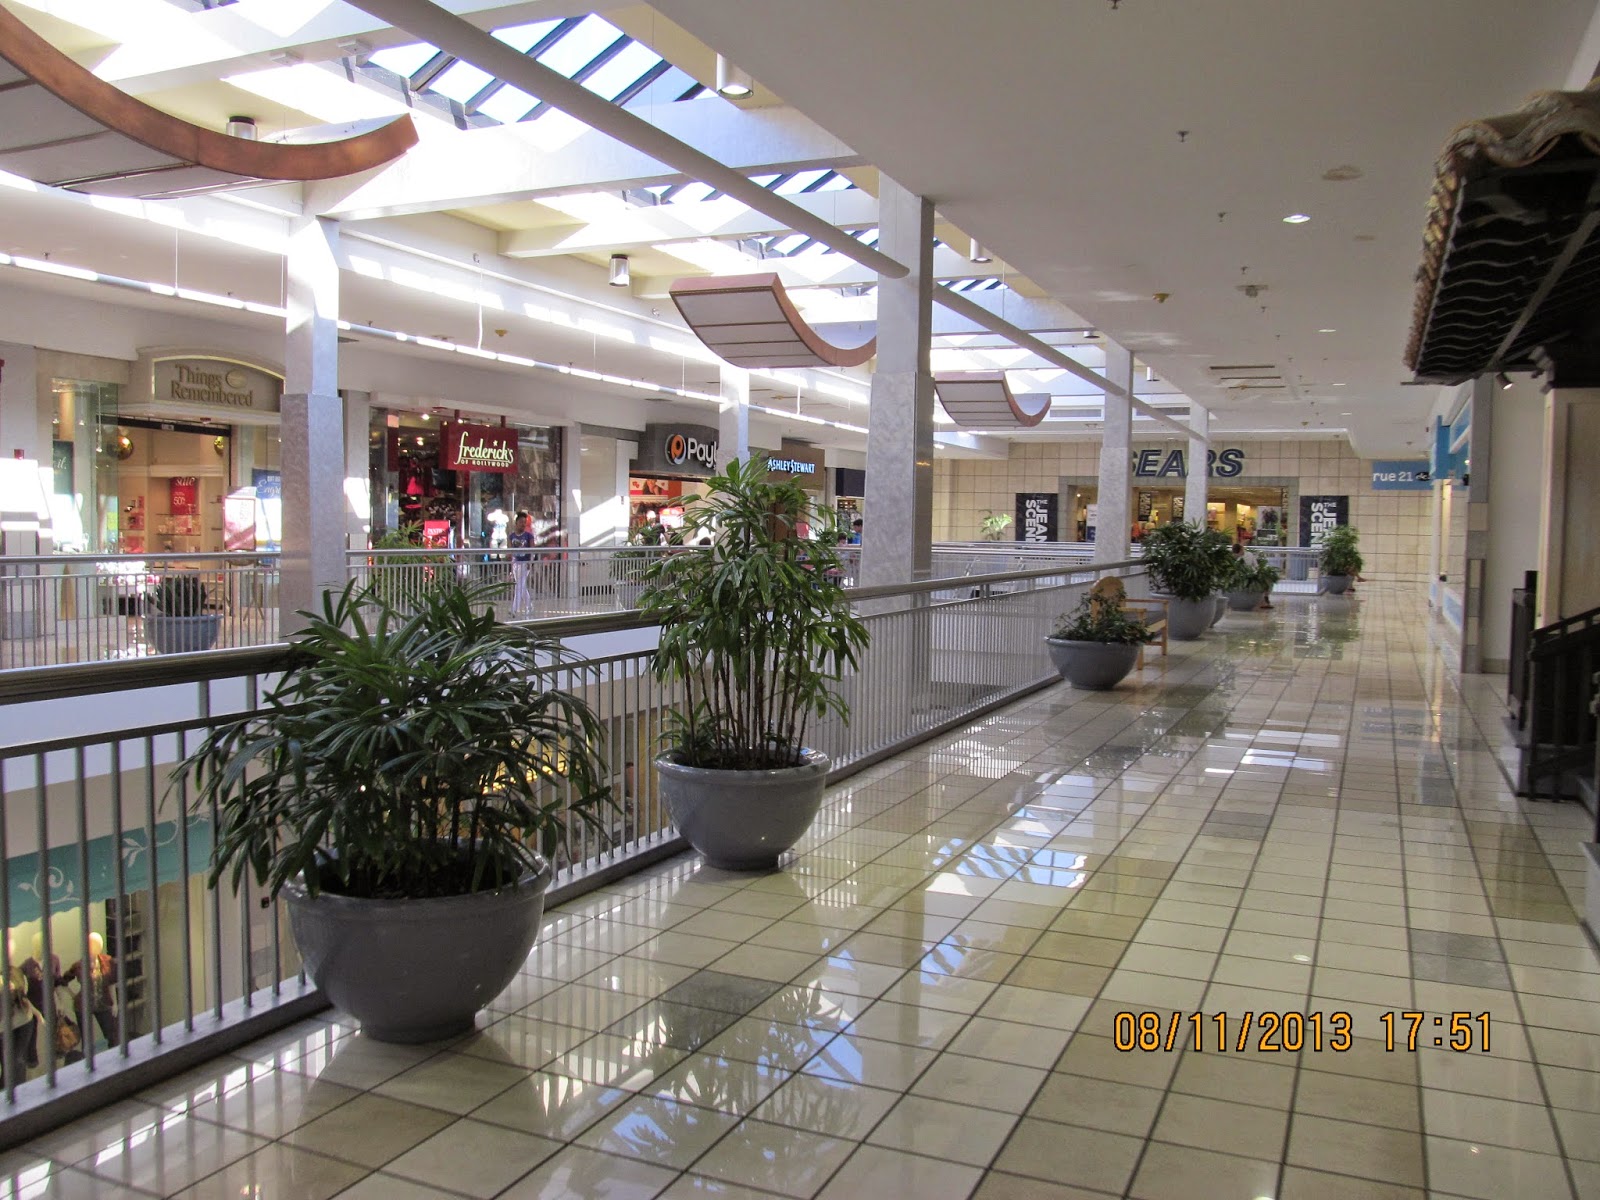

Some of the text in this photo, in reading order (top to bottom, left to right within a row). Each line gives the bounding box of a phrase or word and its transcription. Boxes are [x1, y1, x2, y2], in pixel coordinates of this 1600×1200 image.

[175, 363, 222, 390] Things
[170, 380, 253, 406] Remembered
[453, 431, 514, 465] frederick's
[767, 457, 815, 473] ASHLEY STEWART
[1131, 449, 1245, 477] EAS
[1372, 472, 1396, 482] rue
[1398, 471, 1413, 482] 21
